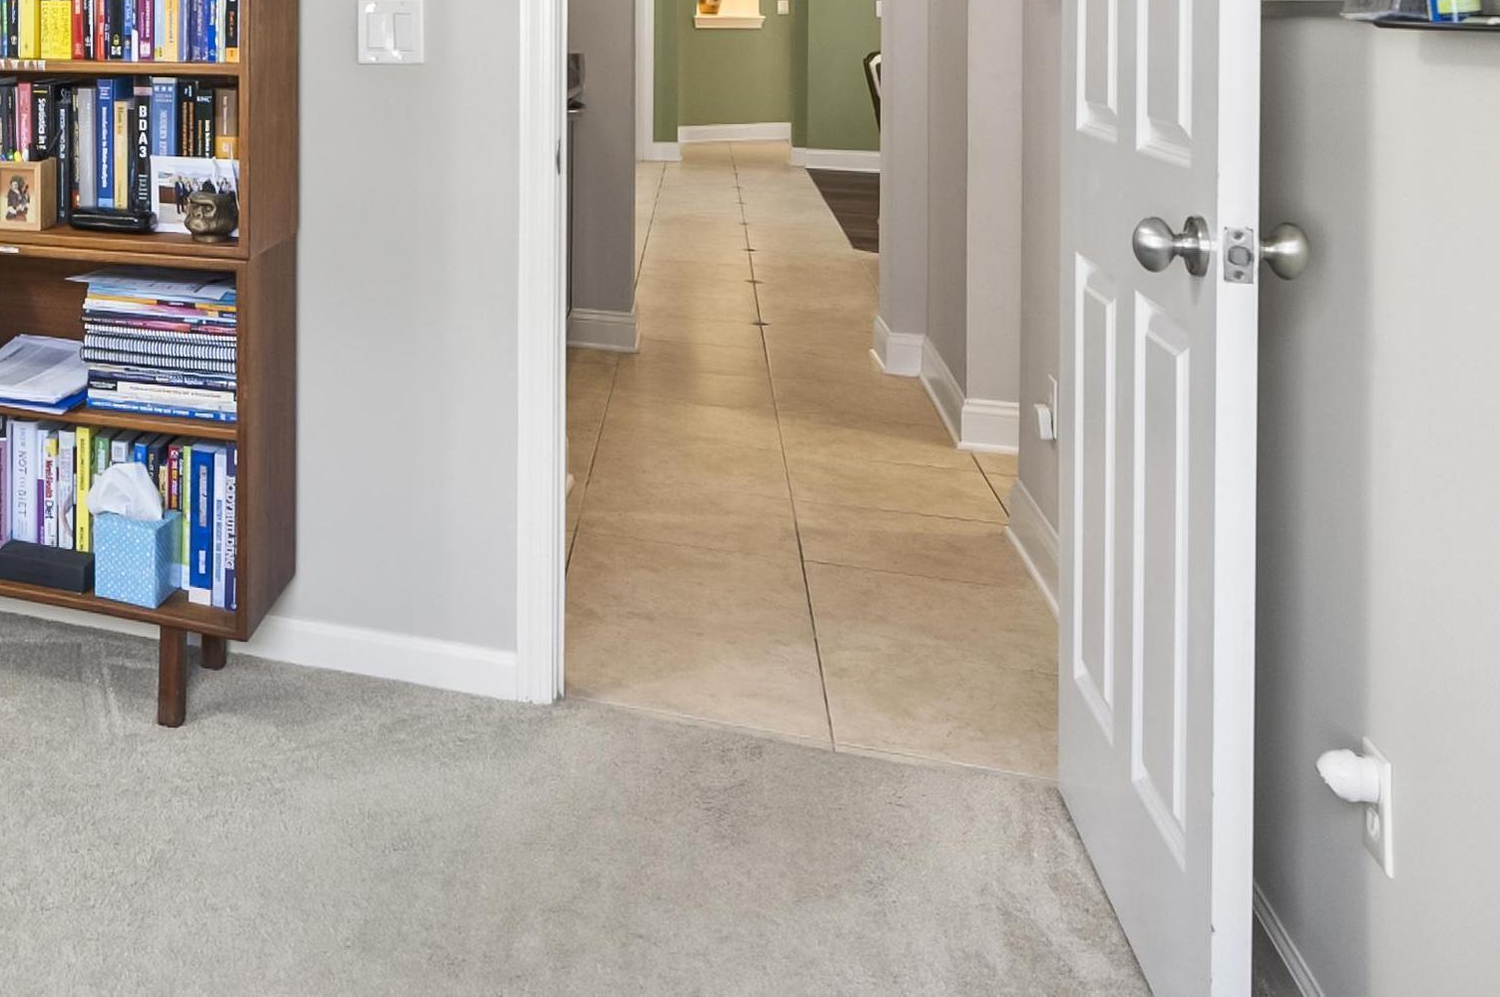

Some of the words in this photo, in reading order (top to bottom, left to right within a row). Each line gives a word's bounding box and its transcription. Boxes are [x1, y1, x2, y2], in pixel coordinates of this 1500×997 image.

[38, 98, 46, 134] Statistics
[38, 135, 46, 143] in
[18, 450, 27, 474] NOT
[18, 489, 27, 517] DIET
[45, 499, 54, 519] Diet
[225, 474, 235, 570] BODYBUILDING
